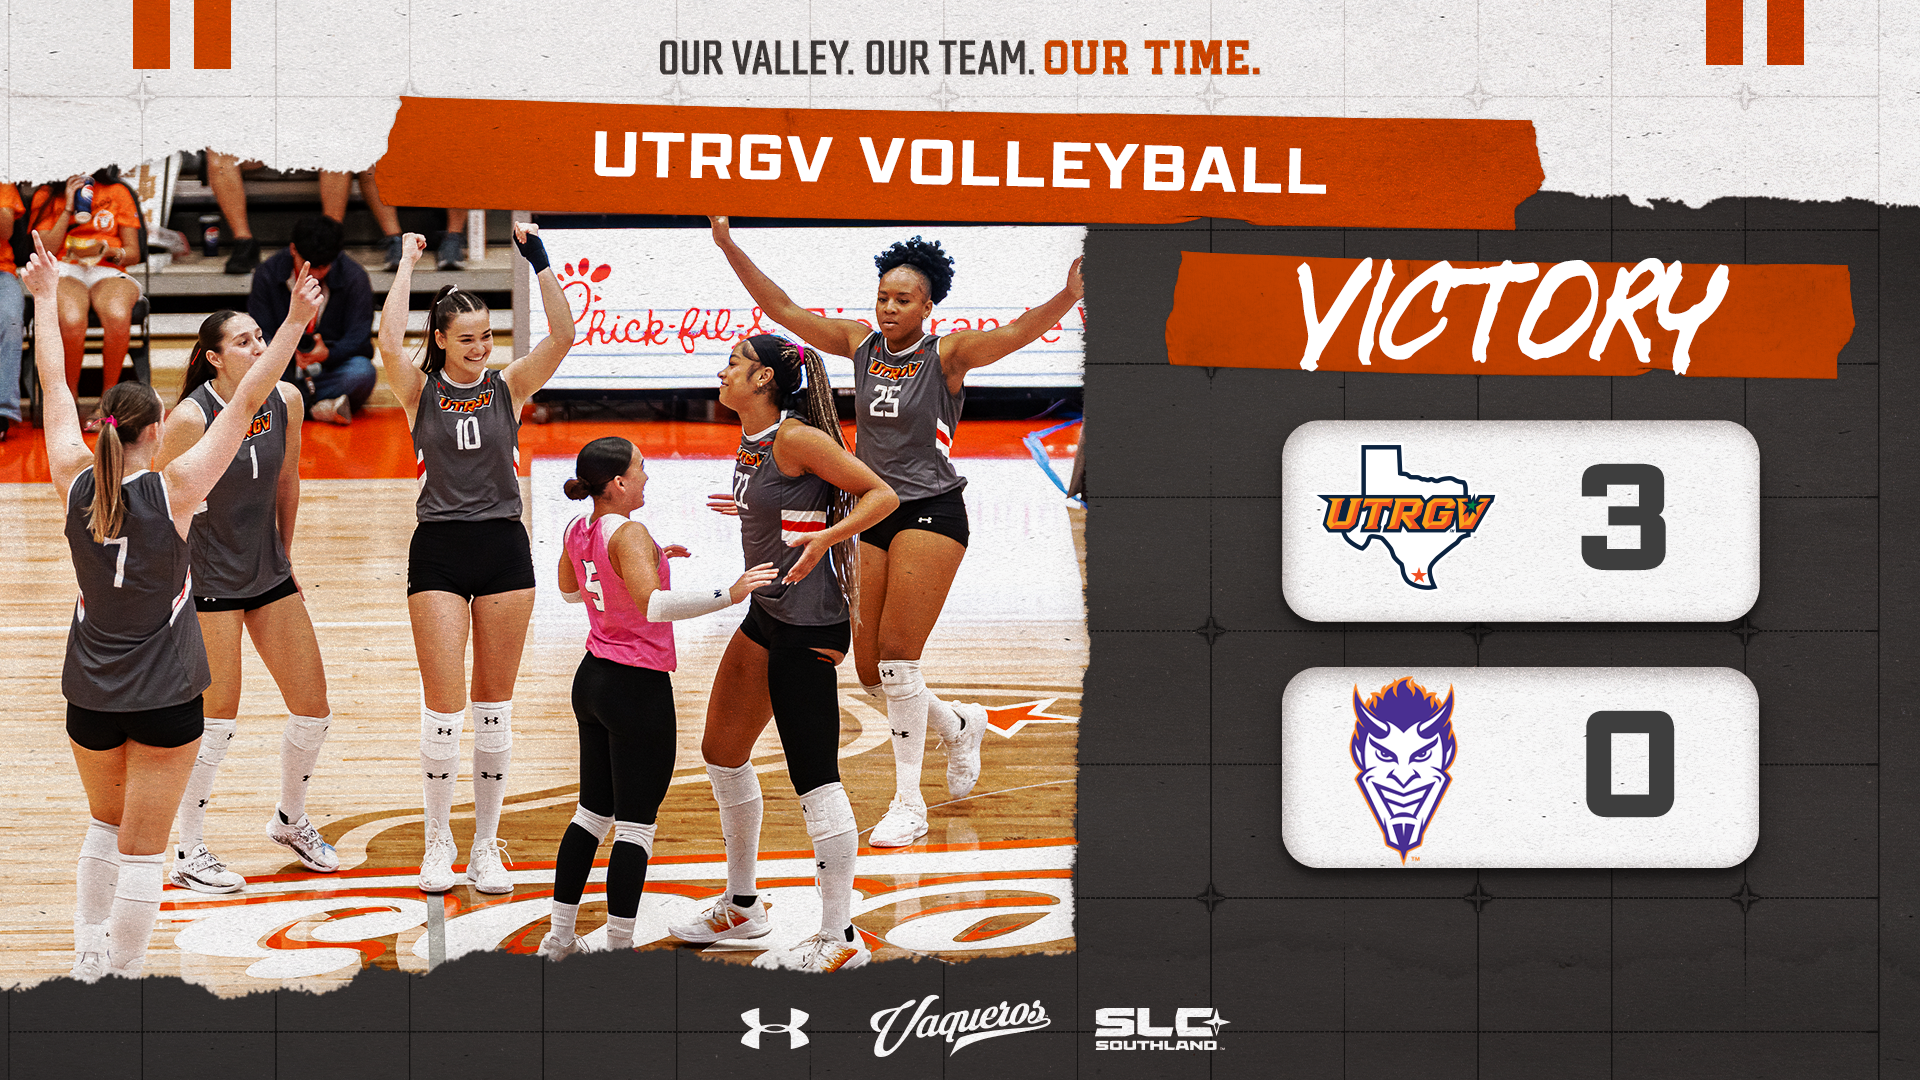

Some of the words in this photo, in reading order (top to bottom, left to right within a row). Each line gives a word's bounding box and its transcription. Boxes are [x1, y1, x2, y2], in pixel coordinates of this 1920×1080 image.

[869, 384, 902, 418] 25
[243, 410, 272, 441] RGV
[455, 415, 482, 450] 10
[249, 444, 259, 480] 1
[733, 470, 751, 511] 22
[103, 535, 128, 588] 7
[581, 558, 605, 613] 5
